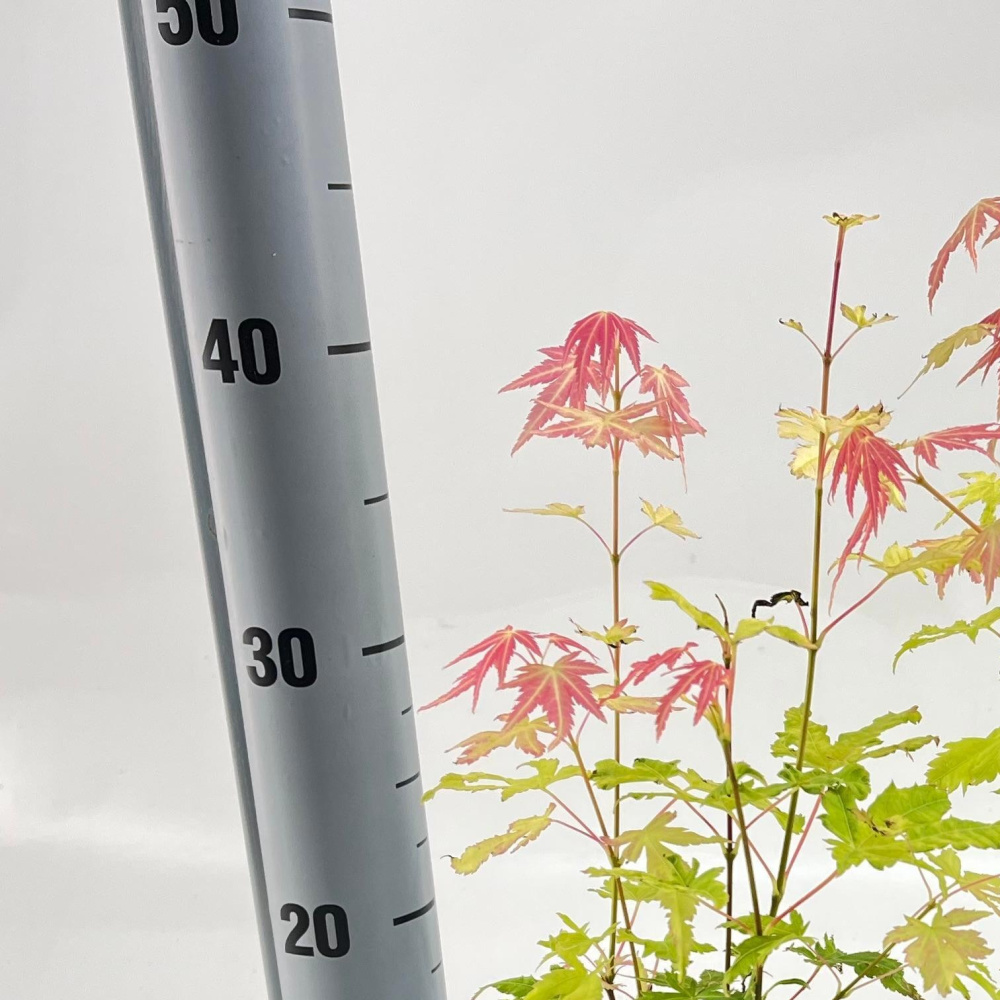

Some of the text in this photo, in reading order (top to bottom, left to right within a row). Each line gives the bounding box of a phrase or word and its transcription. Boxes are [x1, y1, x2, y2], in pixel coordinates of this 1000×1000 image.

[156, 0, 239, 46] 50
[202, 318, 281, 385] 40
[242, 627, 318, 688] 30
[280, 903, 350, 958] 20
